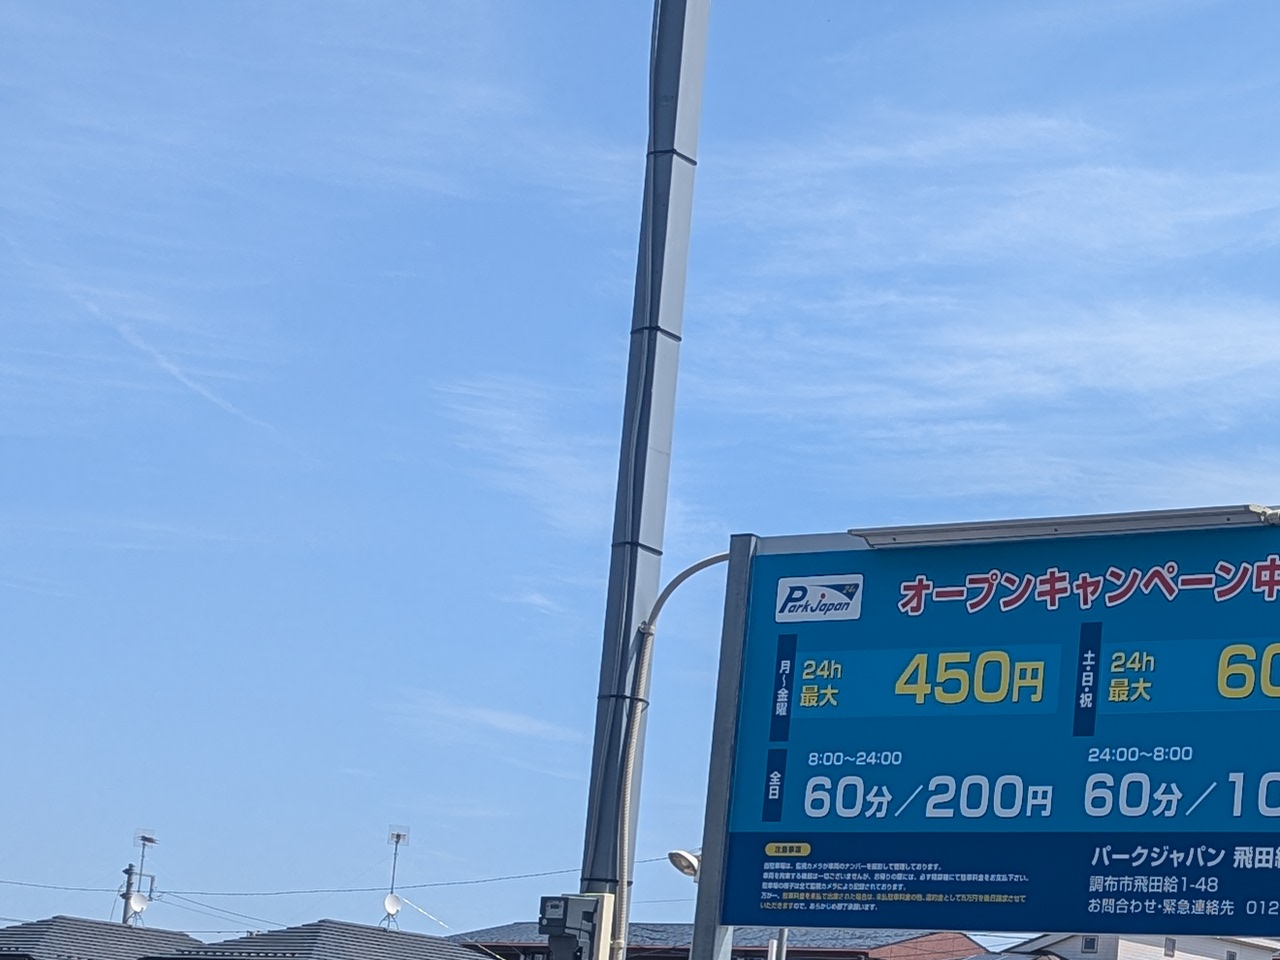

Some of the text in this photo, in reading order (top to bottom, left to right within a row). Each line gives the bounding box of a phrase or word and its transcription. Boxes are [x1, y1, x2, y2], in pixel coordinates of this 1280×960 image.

[802, 660, 842, 680] 24h
[1110, 652, 1155, 673] 24h
[894, 651, 1045, 705] 450円
[800, 684, 839, 707] 最大
[1108, 678, 1152, 702] 最大
[808, 751, 902, 766] 8:00～24:00
[1088, 746, 1193, 762] 24:00～8:00
[768, 771, 782, 799] 全日
[1091, 845, 1225, 868] パークジャパン
[1088, 876, 1218, 893] 調布市飛田給1-48
[1087, 898, 1234, 916] お問合わせ・緊急連絡先
